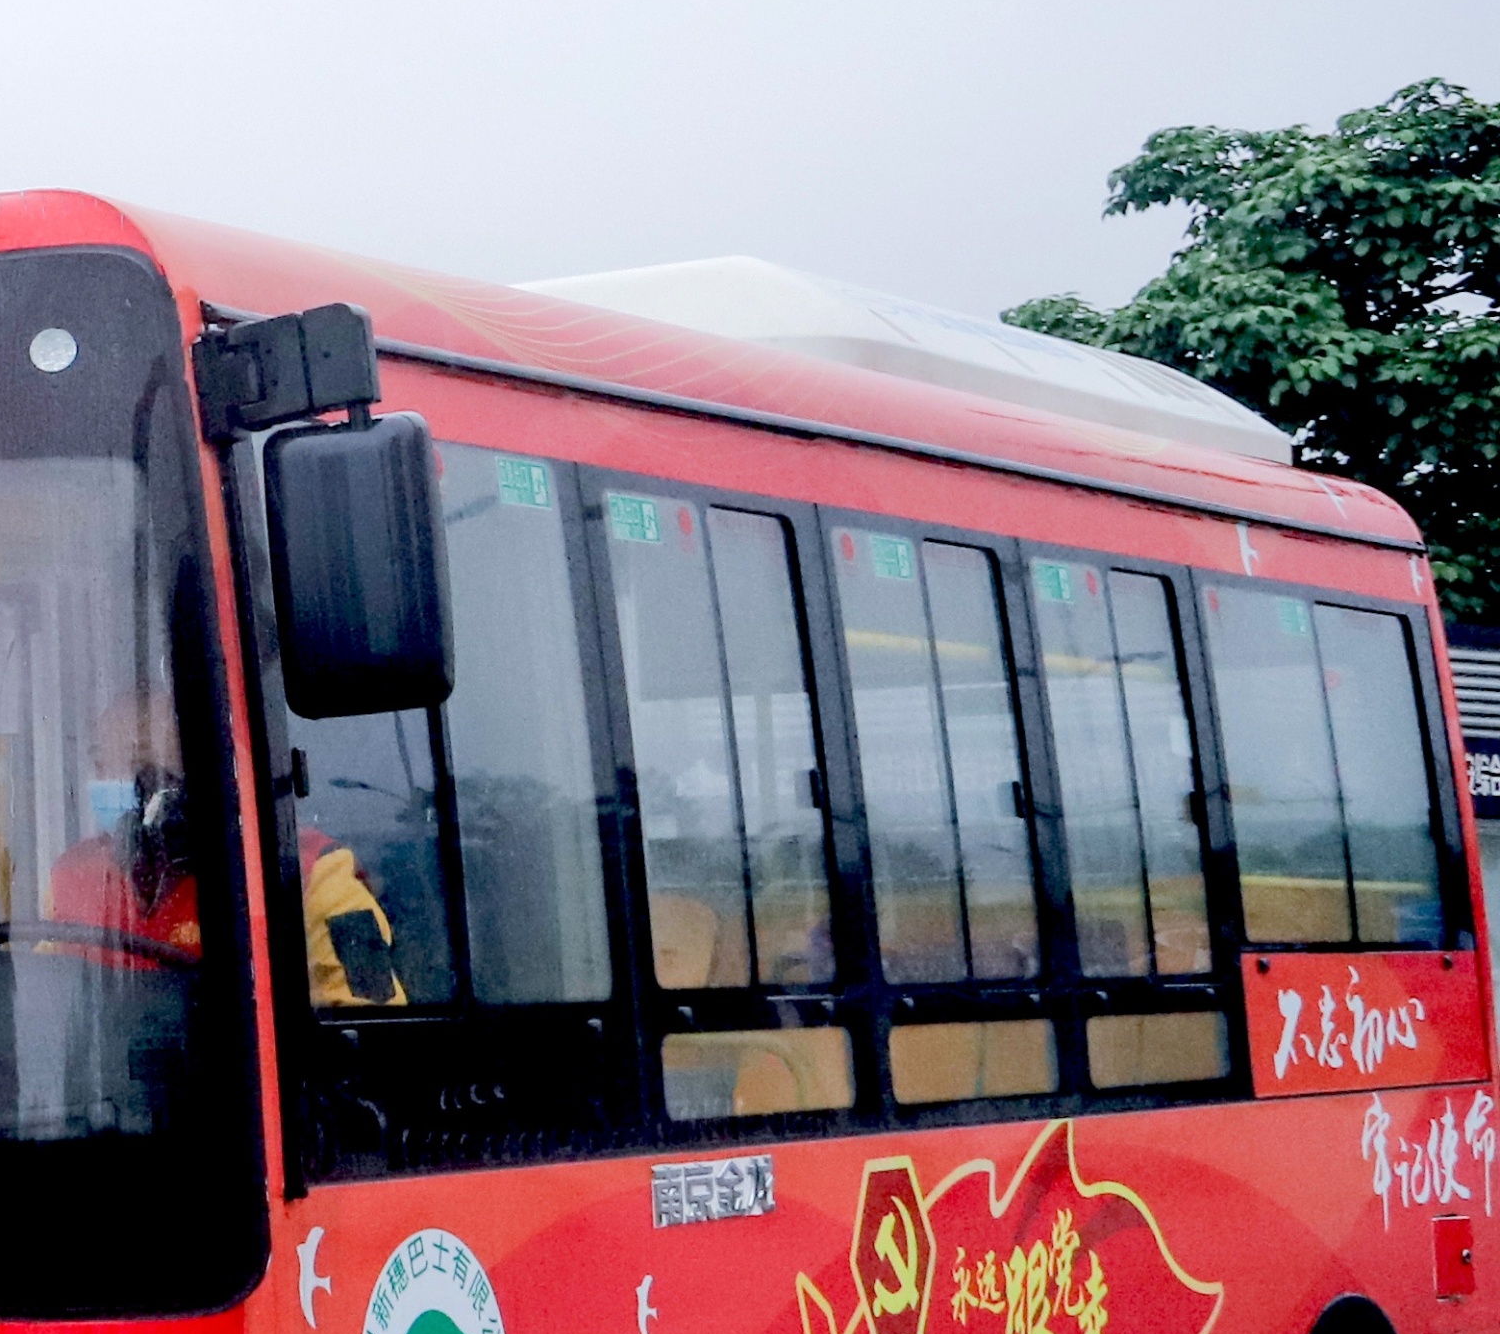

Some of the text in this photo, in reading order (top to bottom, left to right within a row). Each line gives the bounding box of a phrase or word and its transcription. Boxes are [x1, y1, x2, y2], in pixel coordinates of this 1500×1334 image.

[1273, 964, 1426, 1080] 不忘初心
[651, 1154, 776, 1228] 南京金龙
[1360, 1089, 1496, 1233] 牢记使命
